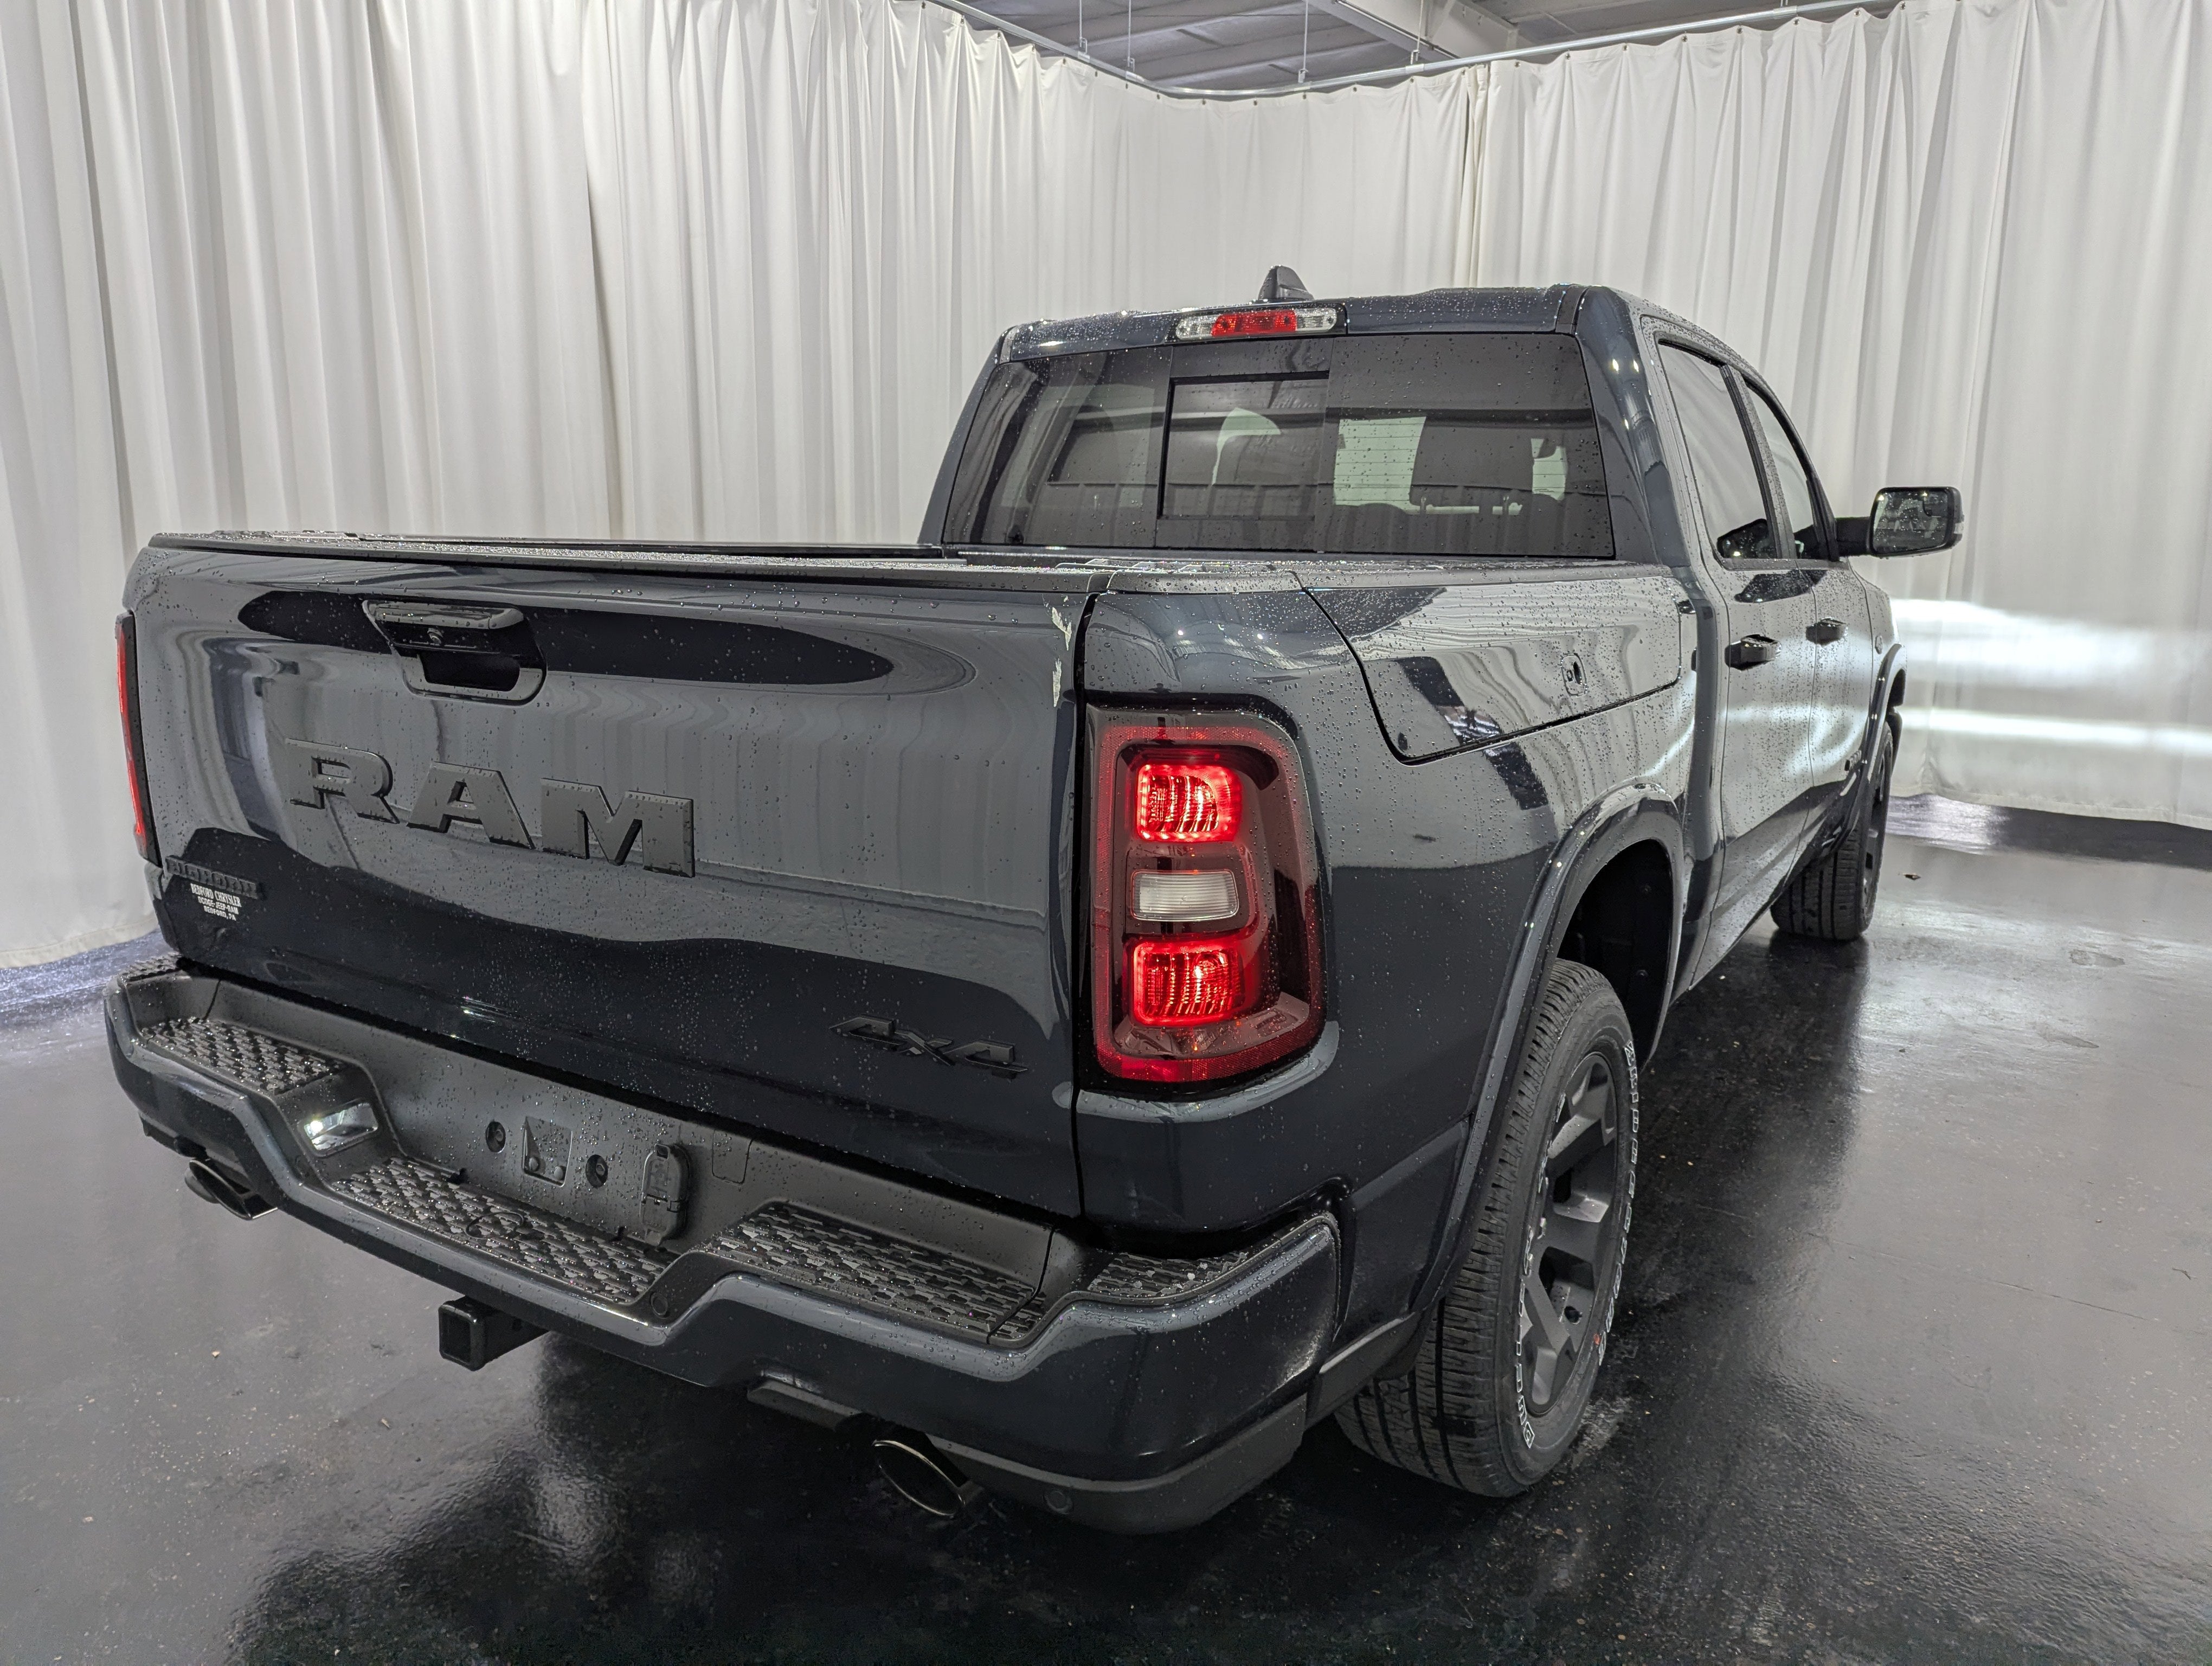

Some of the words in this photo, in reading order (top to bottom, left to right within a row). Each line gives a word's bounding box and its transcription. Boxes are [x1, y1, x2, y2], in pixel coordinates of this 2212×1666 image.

[286, 738, 696, 878] RAM
[190, 883, 214, 899] BEDFORD
[215, 890, 242, 907] CHRYSLER
